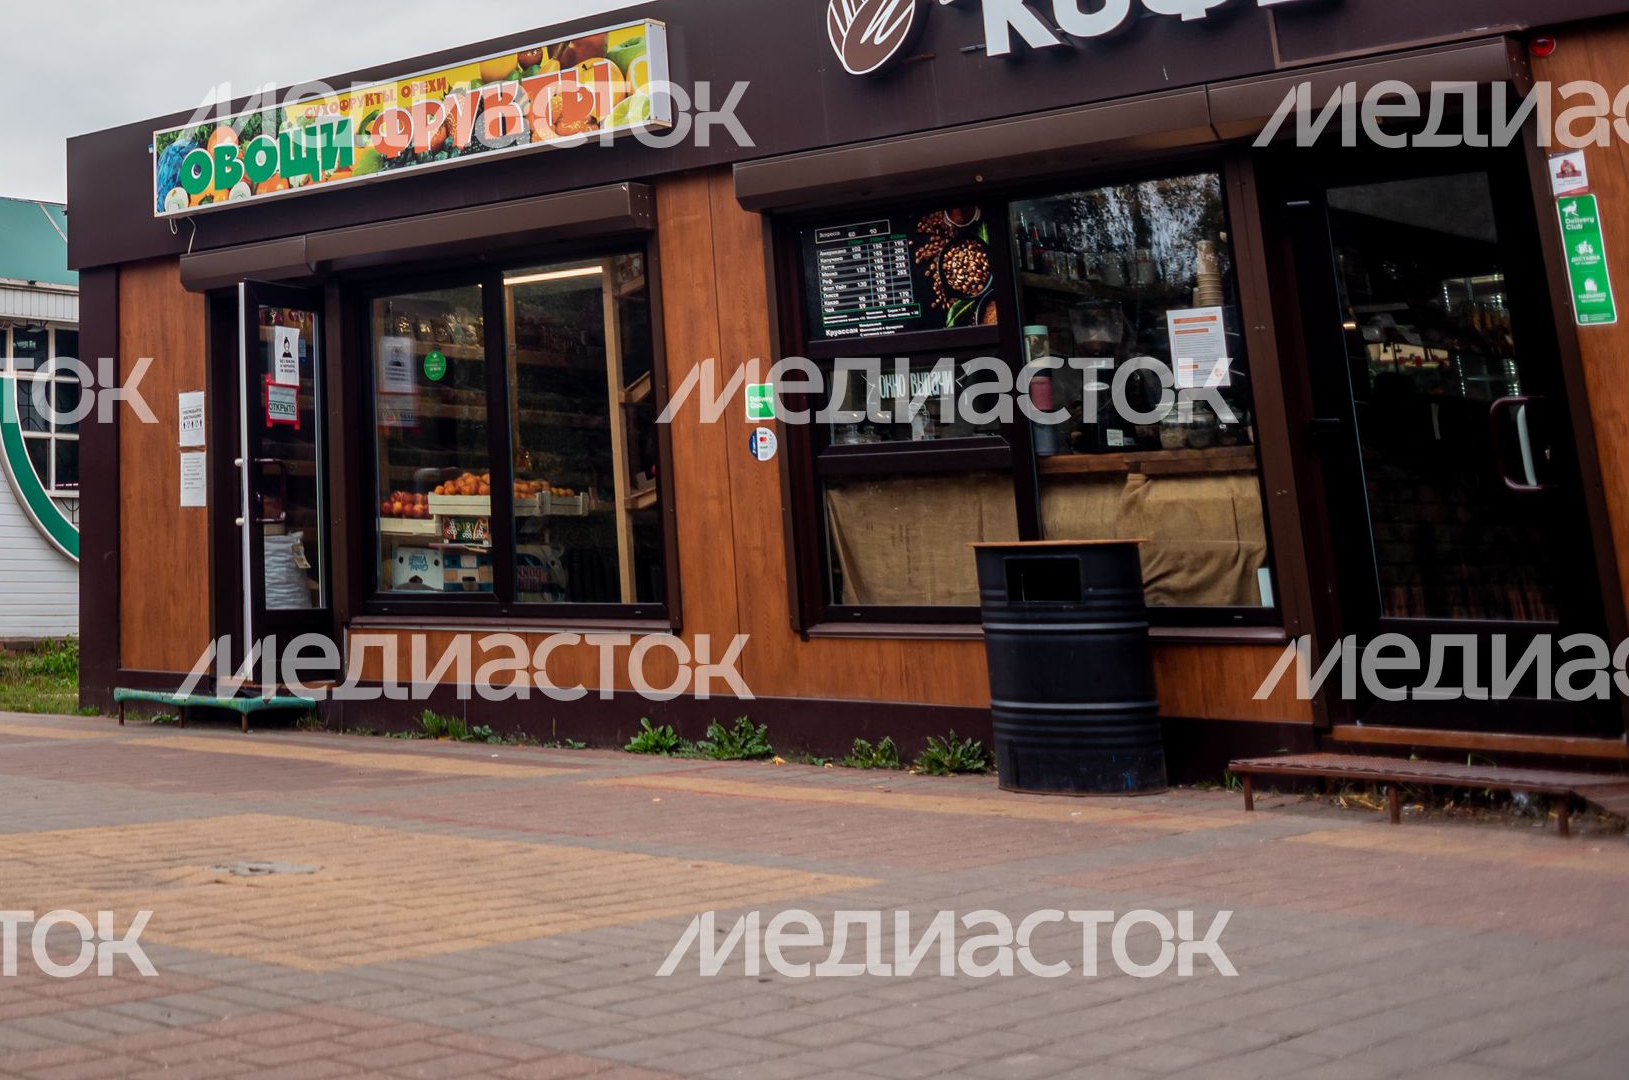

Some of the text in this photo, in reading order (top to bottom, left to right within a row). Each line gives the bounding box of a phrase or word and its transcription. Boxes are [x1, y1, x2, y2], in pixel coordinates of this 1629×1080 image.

[401, 76, 448, 97] ОРЕХИ
[371, 61, 614, 159] ФРУКТЫ
[180, 116, 355, 195] ОВОЩИ
[825, 328, 858, 337] Круассан
[269, 402, 295, 414] ОТКРЫТО
